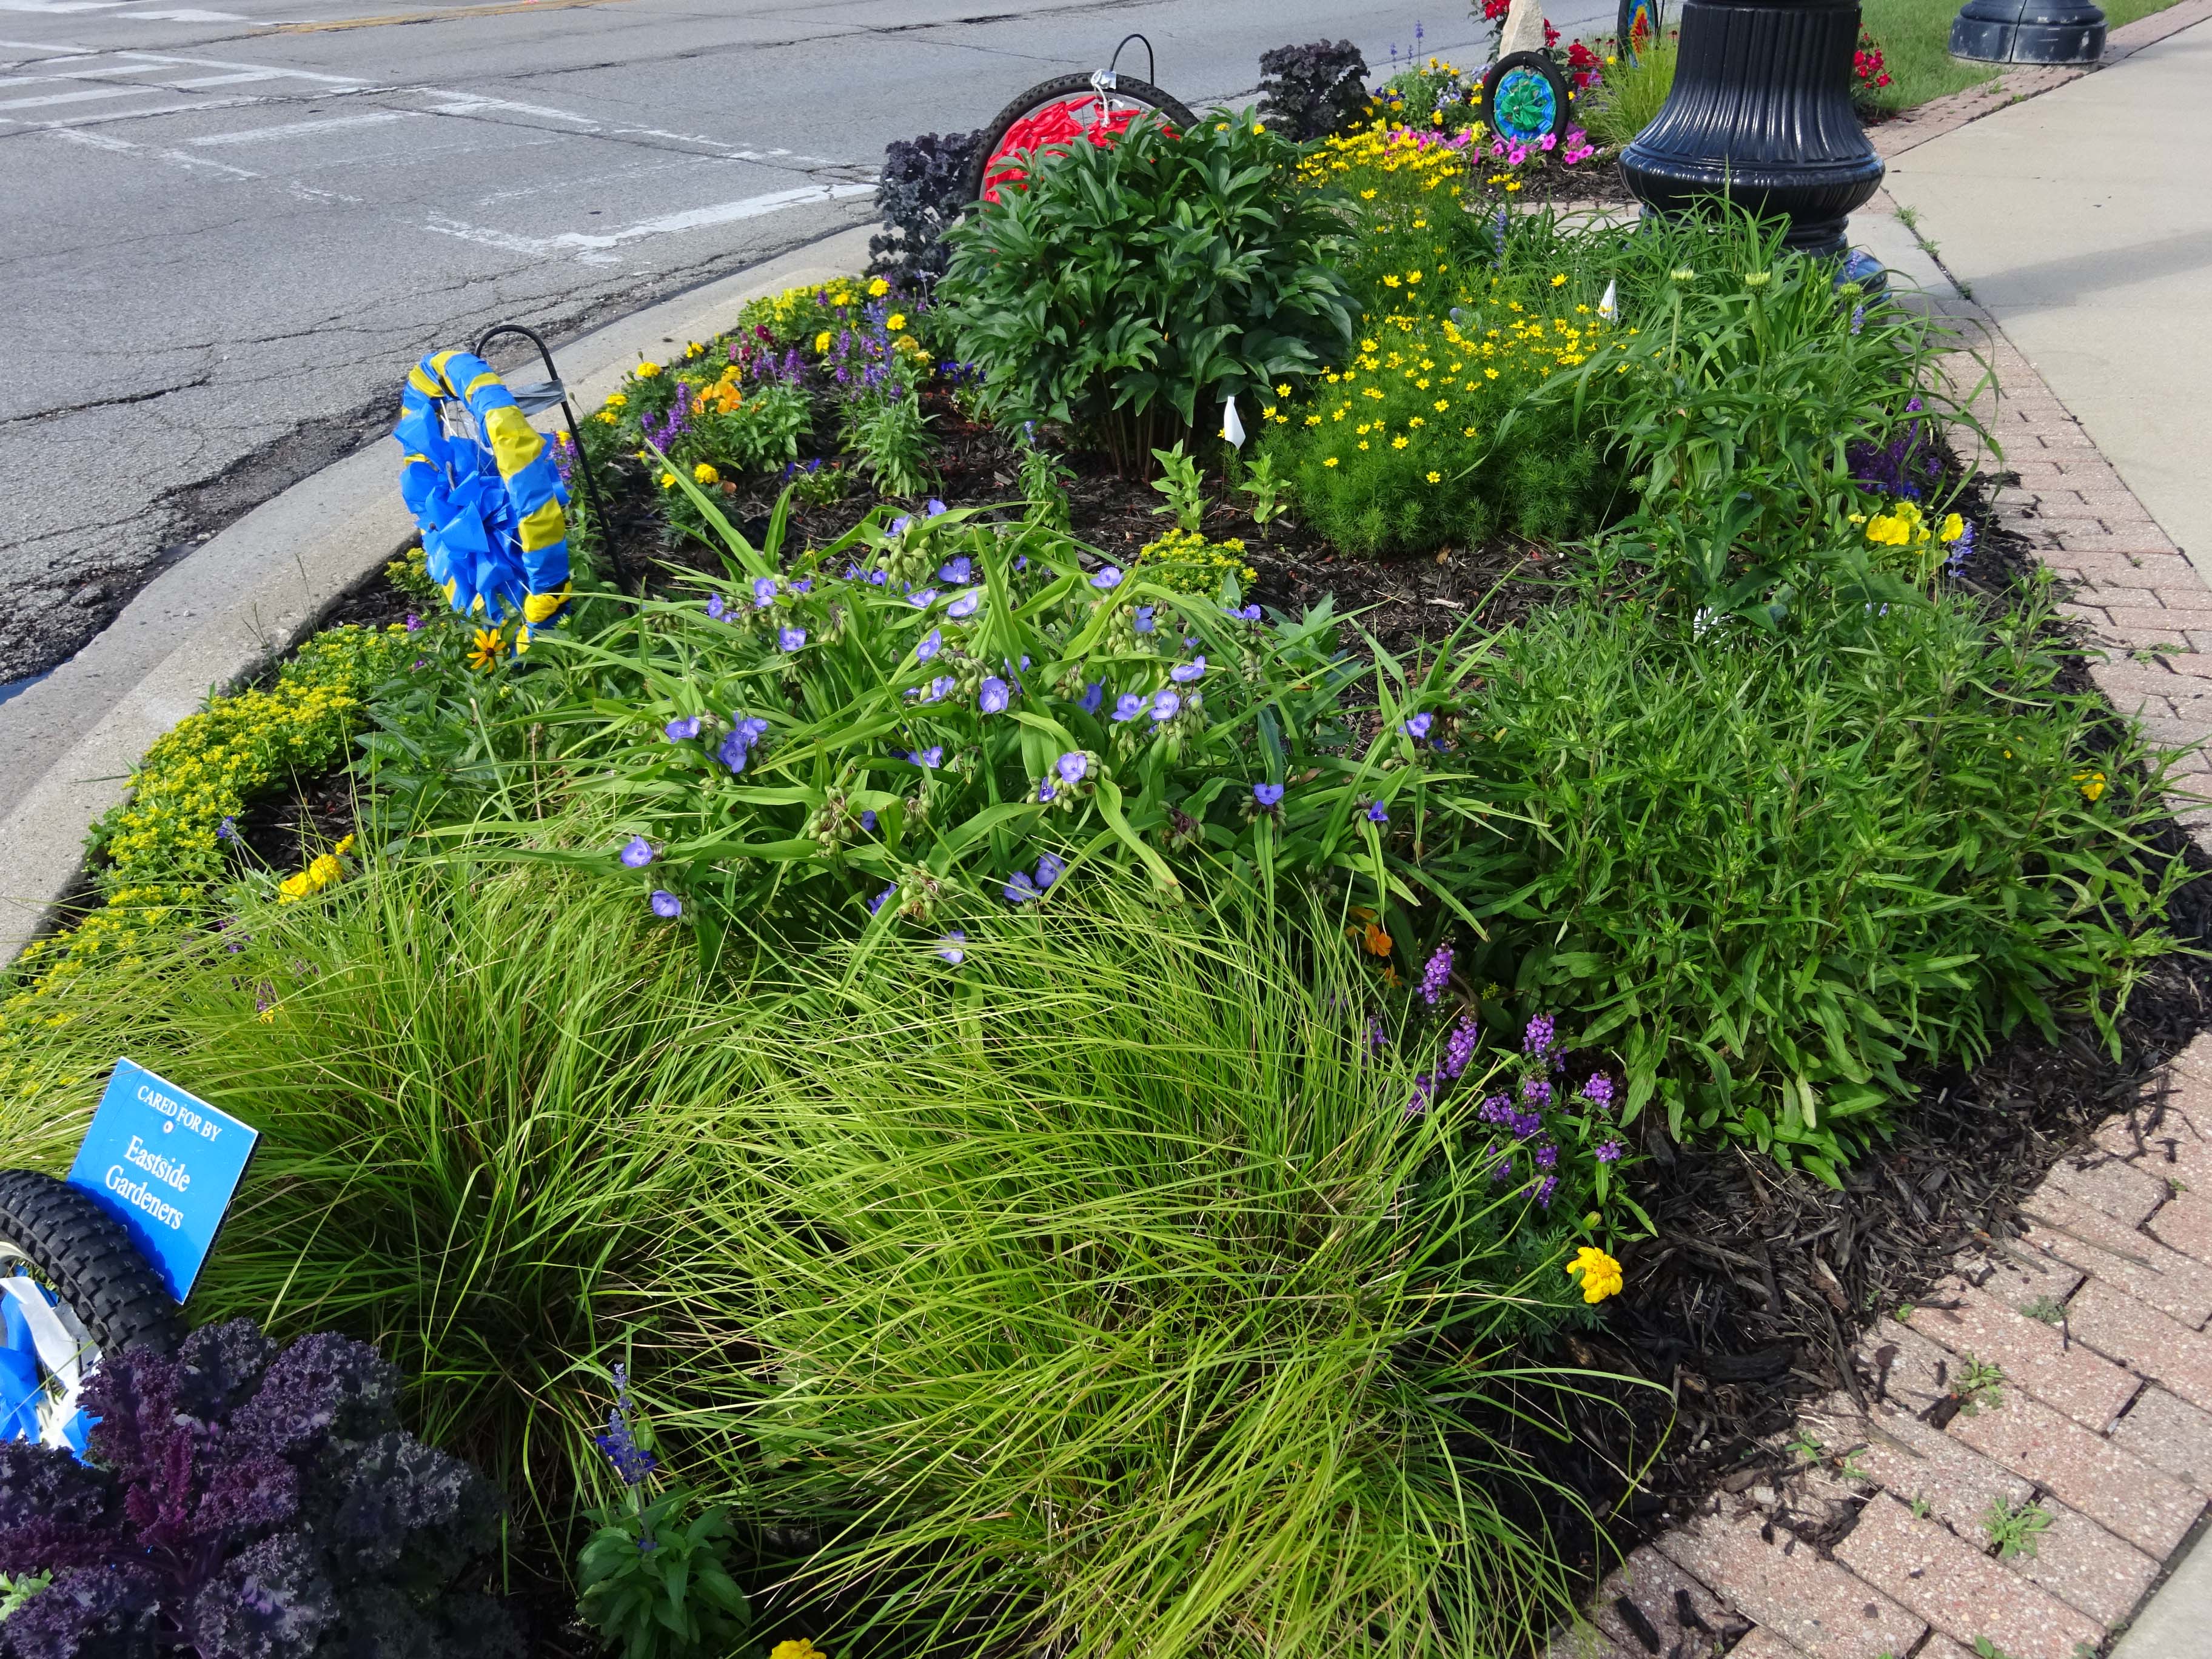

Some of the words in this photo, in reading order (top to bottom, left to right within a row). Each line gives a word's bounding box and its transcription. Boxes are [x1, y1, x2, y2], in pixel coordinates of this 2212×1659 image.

[138, 1085, 178, 1116] CARED
[176, 1107, 202, 1133] FOR
[200, 1121, 223, 1142] BY
[124, 1135, 190, 1192] Eastside
[106, 1165, 184, 1230] Gardeners
